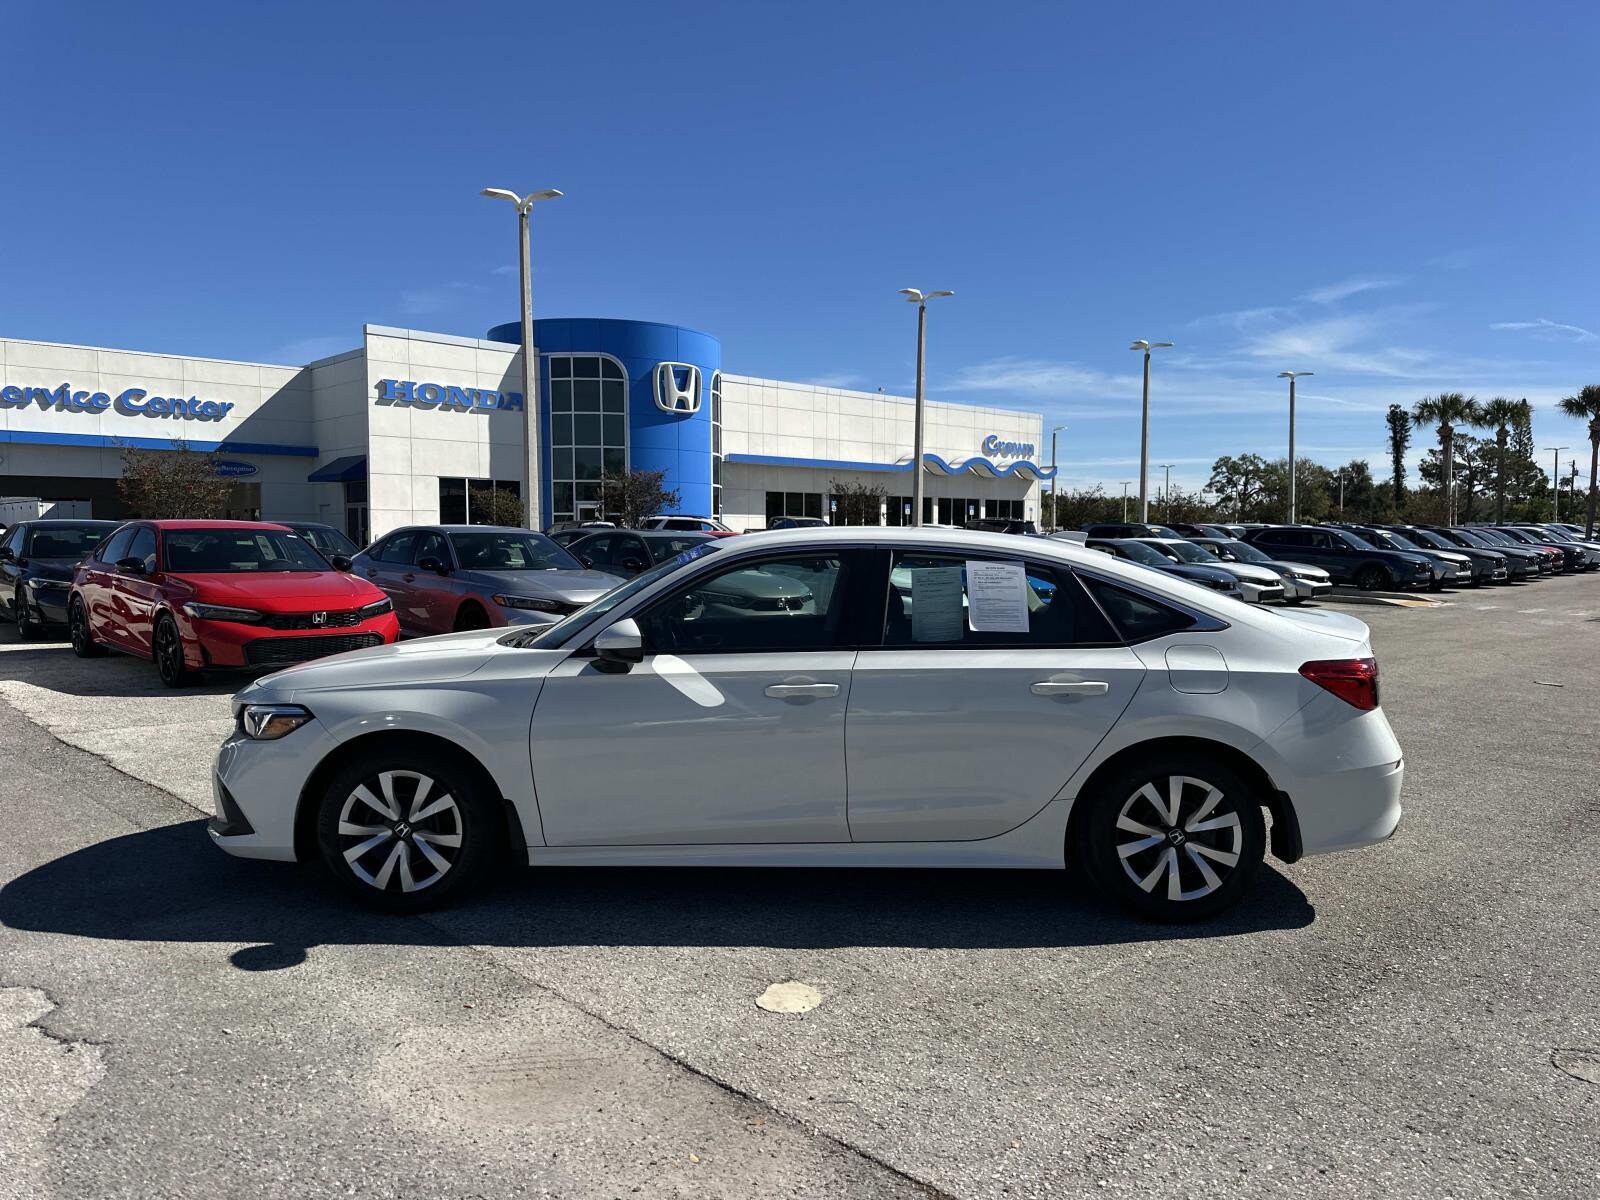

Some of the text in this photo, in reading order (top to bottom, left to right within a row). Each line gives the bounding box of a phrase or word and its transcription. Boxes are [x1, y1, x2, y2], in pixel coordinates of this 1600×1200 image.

[0, 383, 234, 417] ervice Center
[381, 379, 524, 412] HONDA
[983, 435, 1034, 457] Crown
